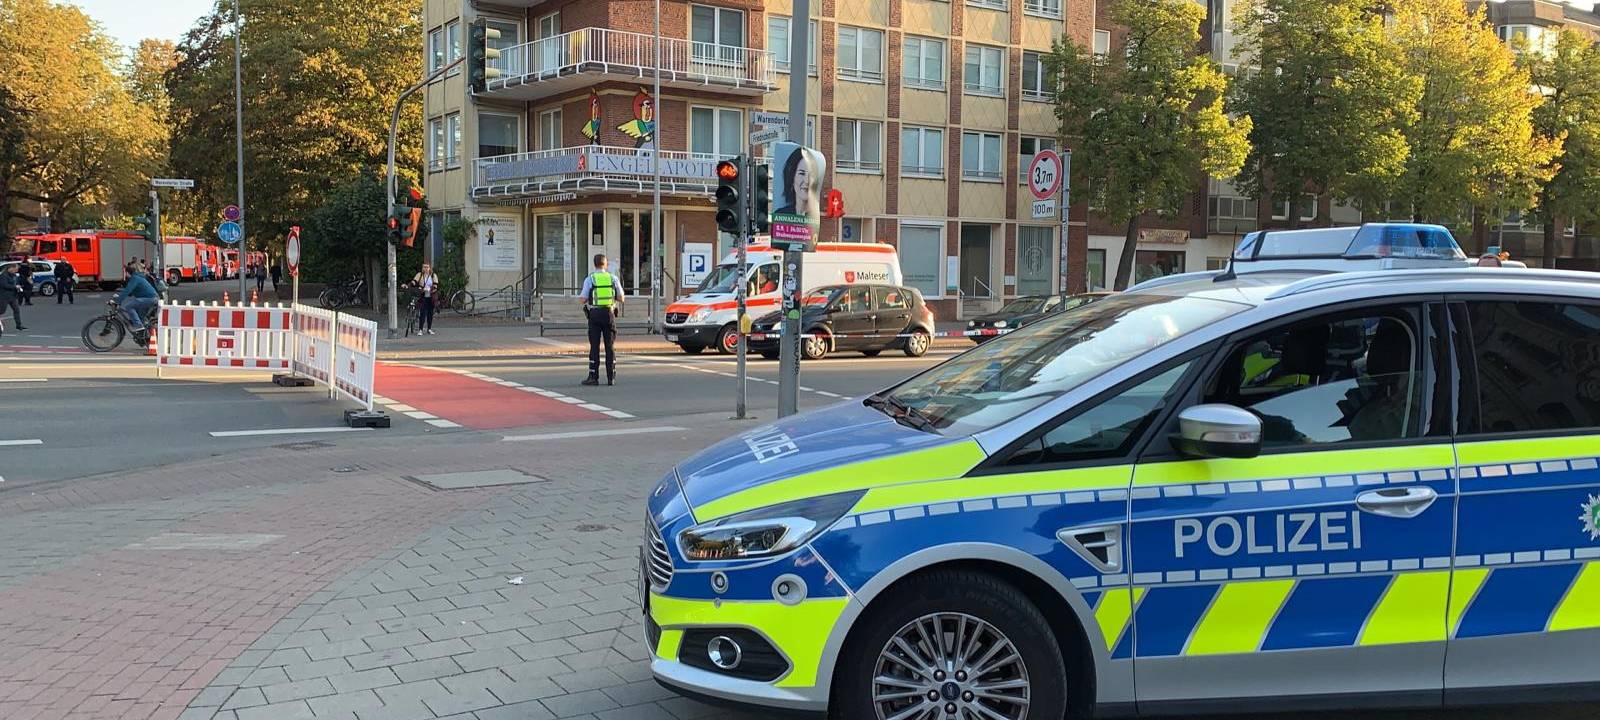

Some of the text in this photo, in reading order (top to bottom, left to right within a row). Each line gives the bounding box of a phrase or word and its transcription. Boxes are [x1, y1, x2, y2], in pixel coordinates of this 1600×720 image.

[843, 225, 852, 239] 3
[691, 256, 703, 271] P
[856, 271, 889, 281] Malteser
[1174, 510, 1361, 558] POLIZEI
